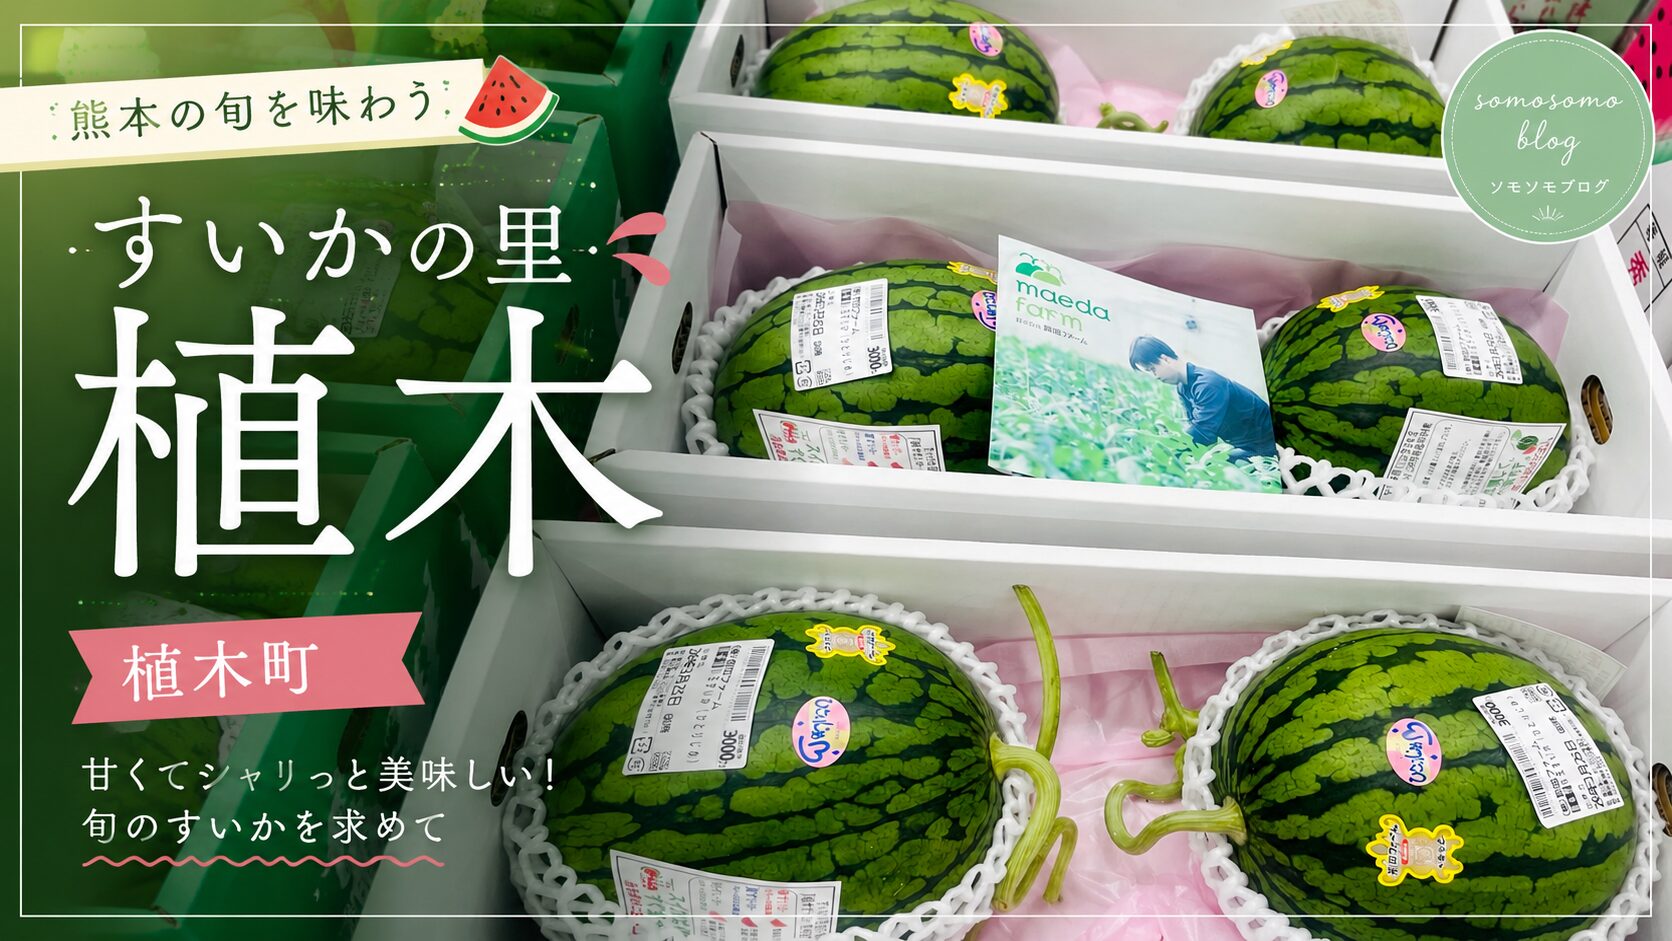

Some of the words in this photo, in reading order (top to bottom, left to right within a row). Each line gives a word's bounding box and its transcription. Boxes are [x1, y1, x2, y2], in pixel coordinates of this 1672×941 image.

[1016, 279, 1111, 321] maeda
[1016, 297, 1083, 331] farm
[1485, 701, 1511, 727] 3000
[719, 729, 738, 762] 3000
